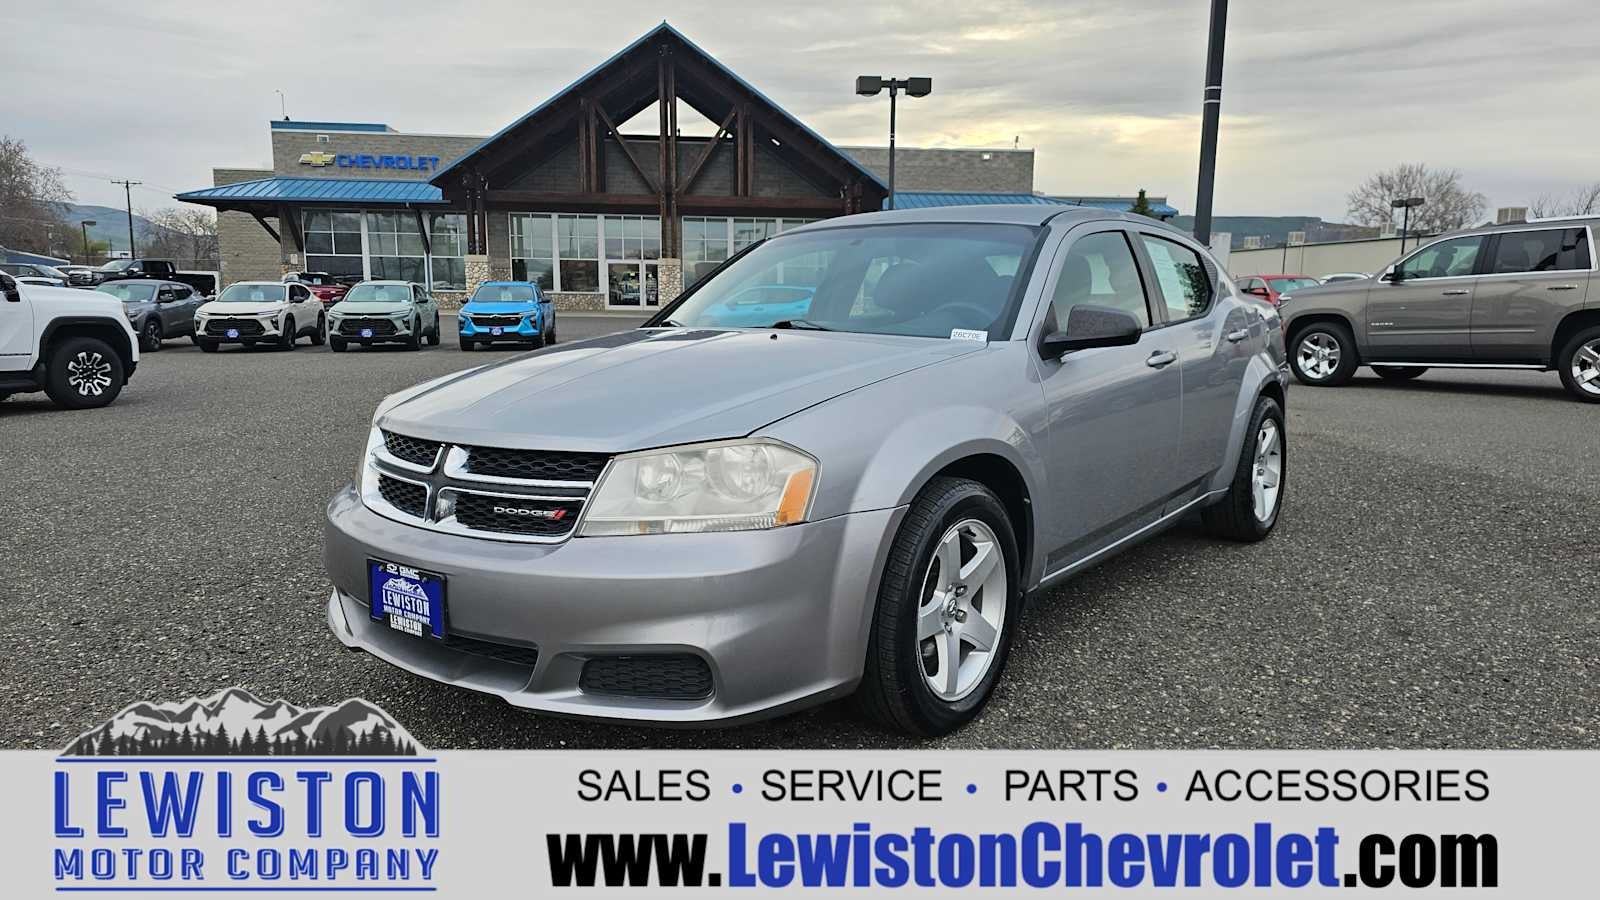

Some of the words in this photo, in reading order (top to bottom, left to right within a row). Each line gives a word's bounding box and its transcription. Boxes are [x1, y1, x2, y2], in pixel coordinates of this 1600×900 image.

[336, 153, 440, 170] CHEVROLET
[494, 506, 554, 517] DODGE
[399, 566, 420, 580] GMC
[383, 589, 430, 616] LEWISTON
[384, 604, 403, 617] MOTOR
[404, 610, 430, 624] COMPANY
[390, 614, 423, 632] LEWISTON
